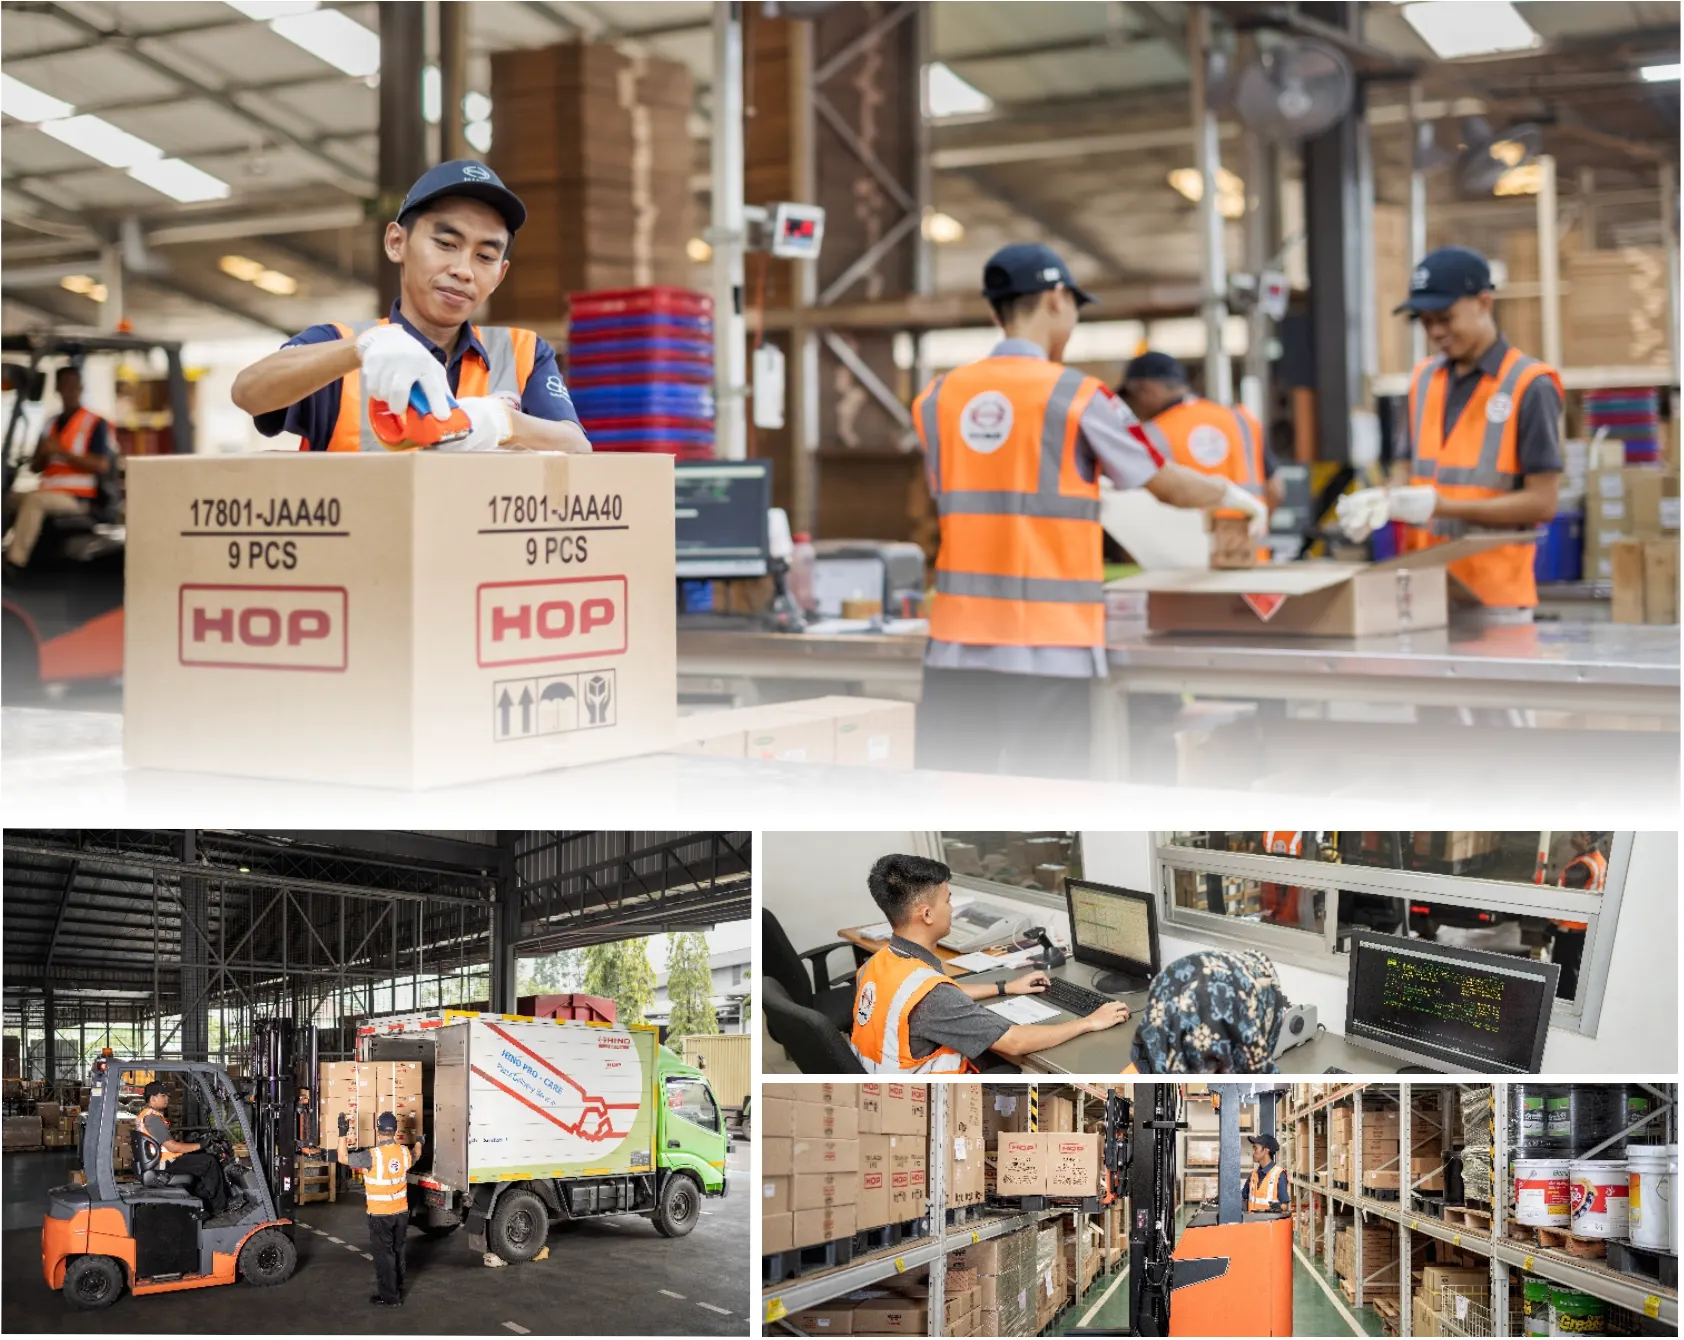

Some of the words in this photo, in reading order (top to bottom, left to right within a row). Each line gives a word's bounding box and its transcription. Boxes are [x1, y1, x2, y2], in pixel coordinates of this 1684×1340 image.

[190, 497, 341, 527] 17801-JAA40
[488, 494, 622, 523] 17801-JAA40
[228, 541, 241, 569] 9
[249, 541, 298, 570] PCS
[526, 538, 537, 565] 9
[545, 535, 588, 564] PCS
[193, 607, 331, 647] HOP
[492, 598, 615, 642] HOP
[501, 1050, 522, 1067] HINO
[543, 1078, 564, 1095] CARE
